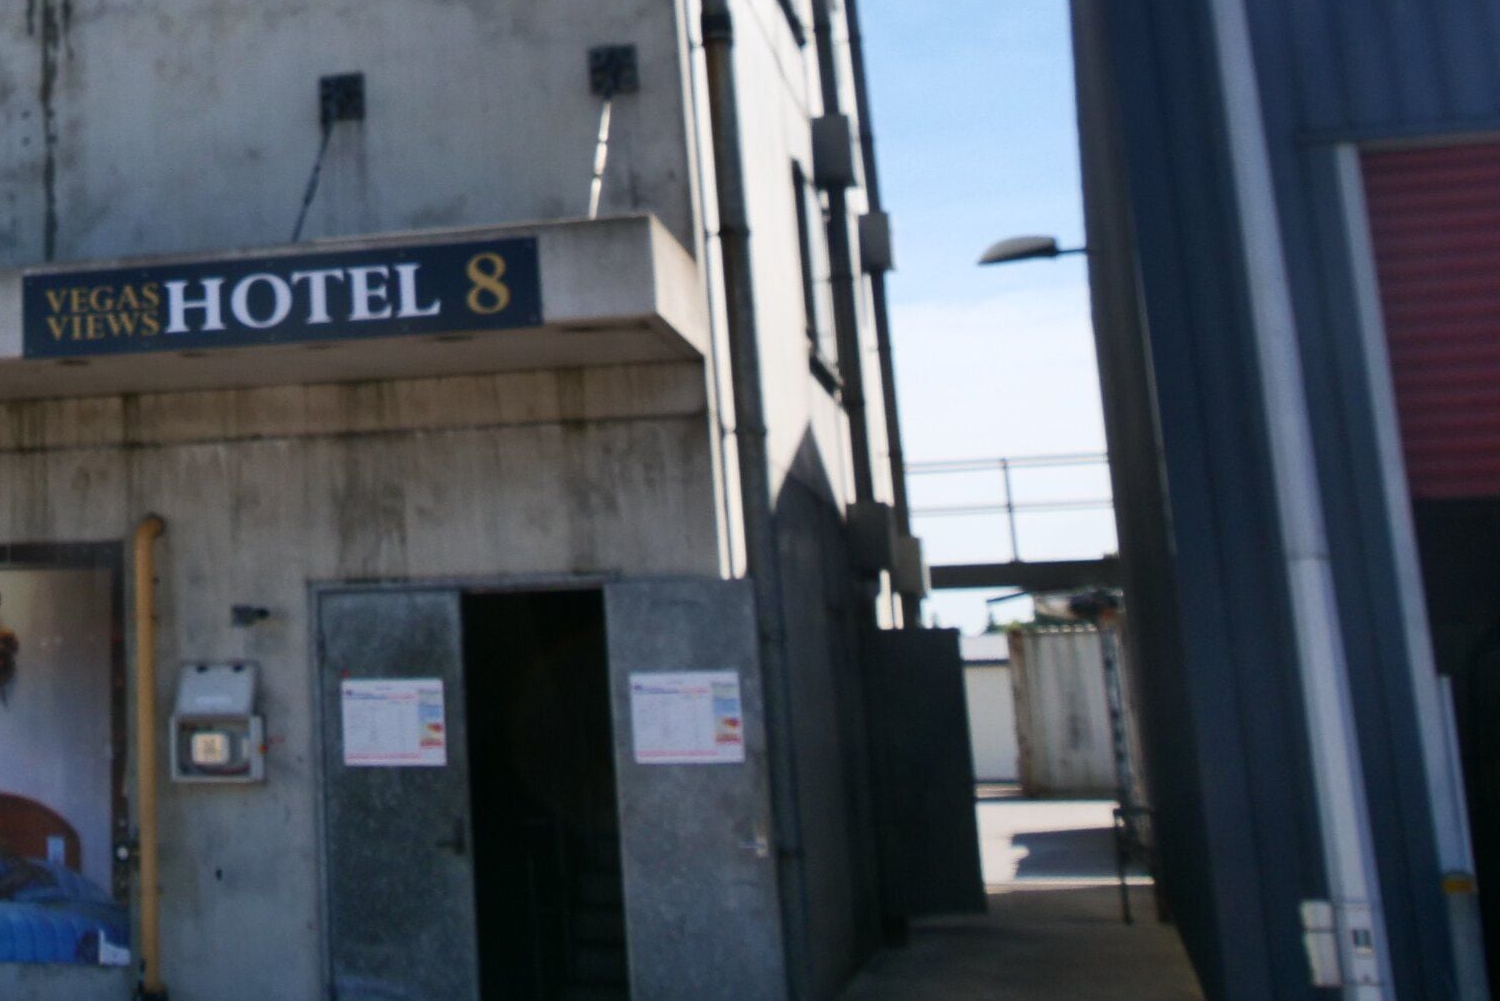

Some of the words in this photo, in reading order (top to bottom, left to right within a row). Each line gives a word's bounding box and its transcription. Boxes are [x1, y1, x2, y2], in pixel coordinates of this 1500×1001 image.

[46, 282, 160, 314] VEGAS
[165, 263, 440, 334] HOTEL
[466, 252, 511, 314] 8
[46, 309, 160, 341] VIEWS
